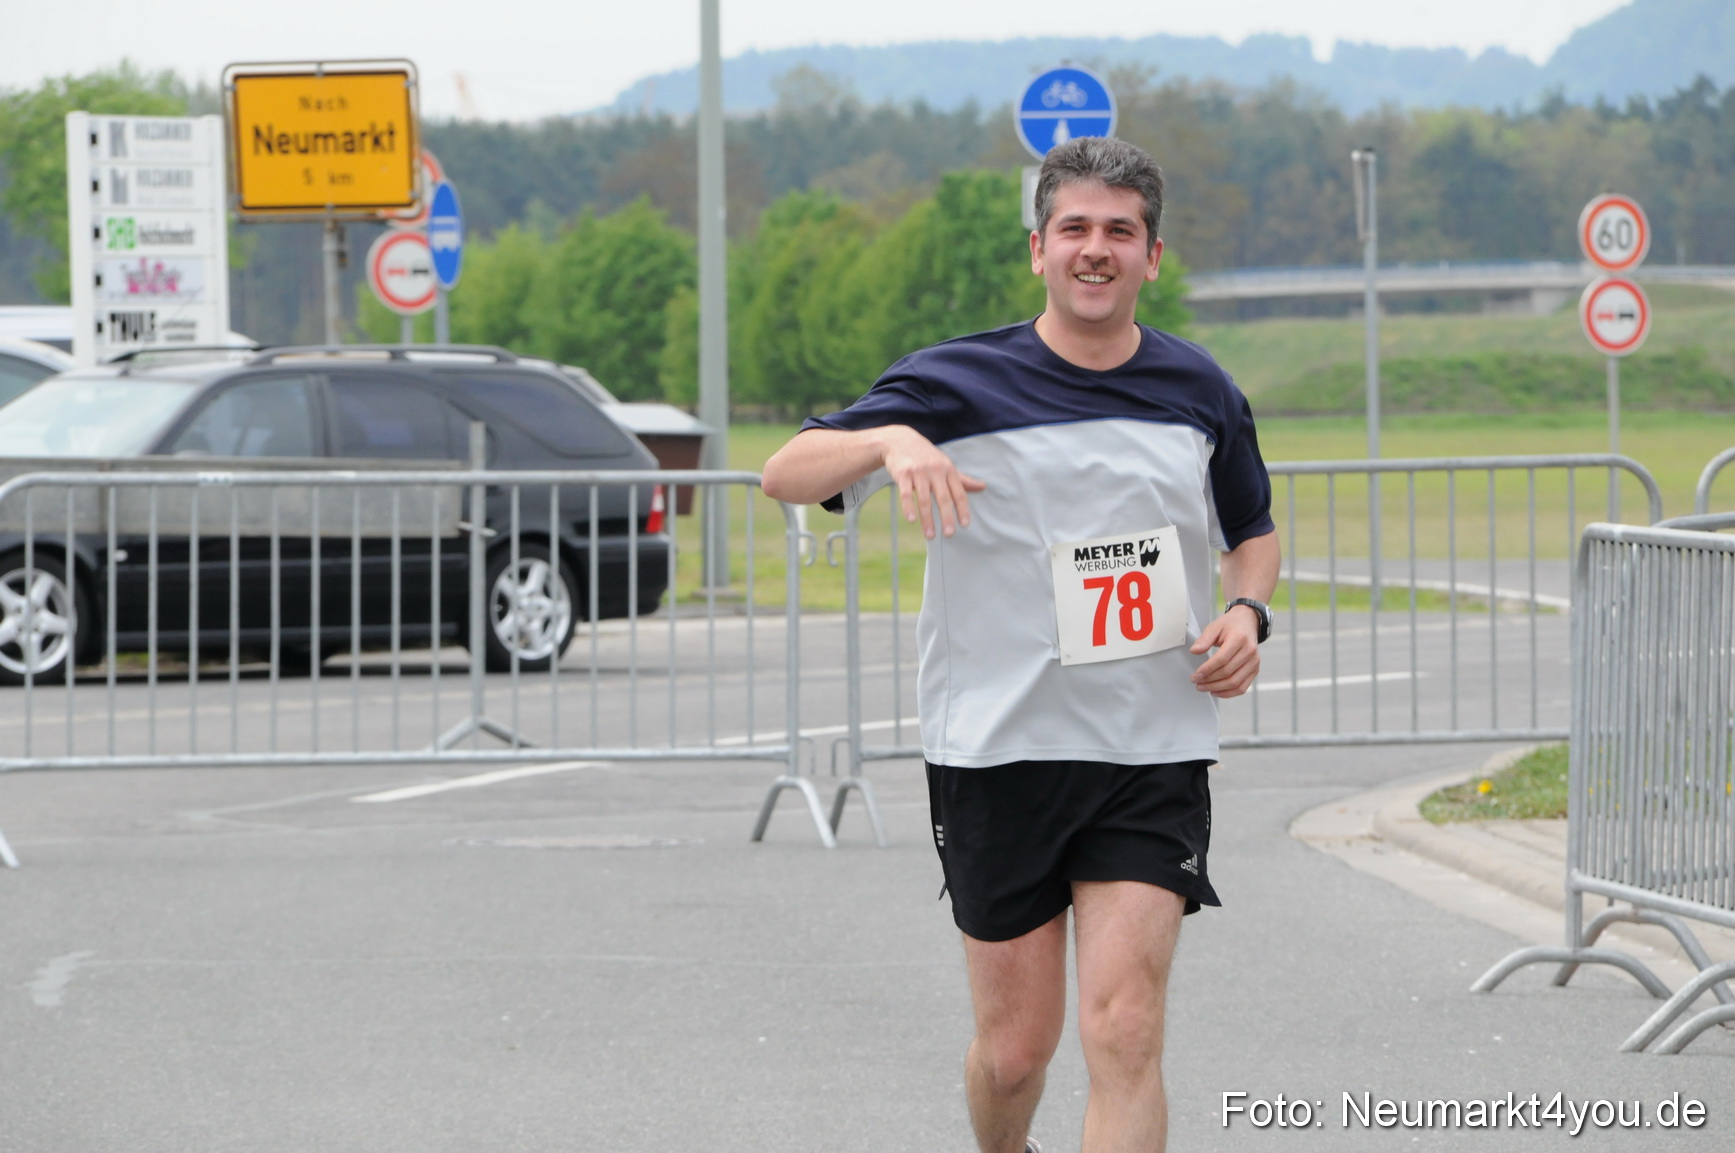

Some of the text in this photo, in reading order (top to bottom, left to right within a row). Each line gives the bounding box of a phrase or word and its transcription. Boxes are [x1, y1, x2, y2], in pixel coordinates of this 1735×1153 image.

[298, 95, 348, 111] Nach
[253, 122, 396, 155] Neumarkt
[303, 168, 354, 185] 5 km
[1597, 216, 1634, 251] 60
[1074, 542, 1135, 562] MEYER
[1075, 556, 1137, 572] WERBUNG
[1083, 571, 1154, 647] 78
